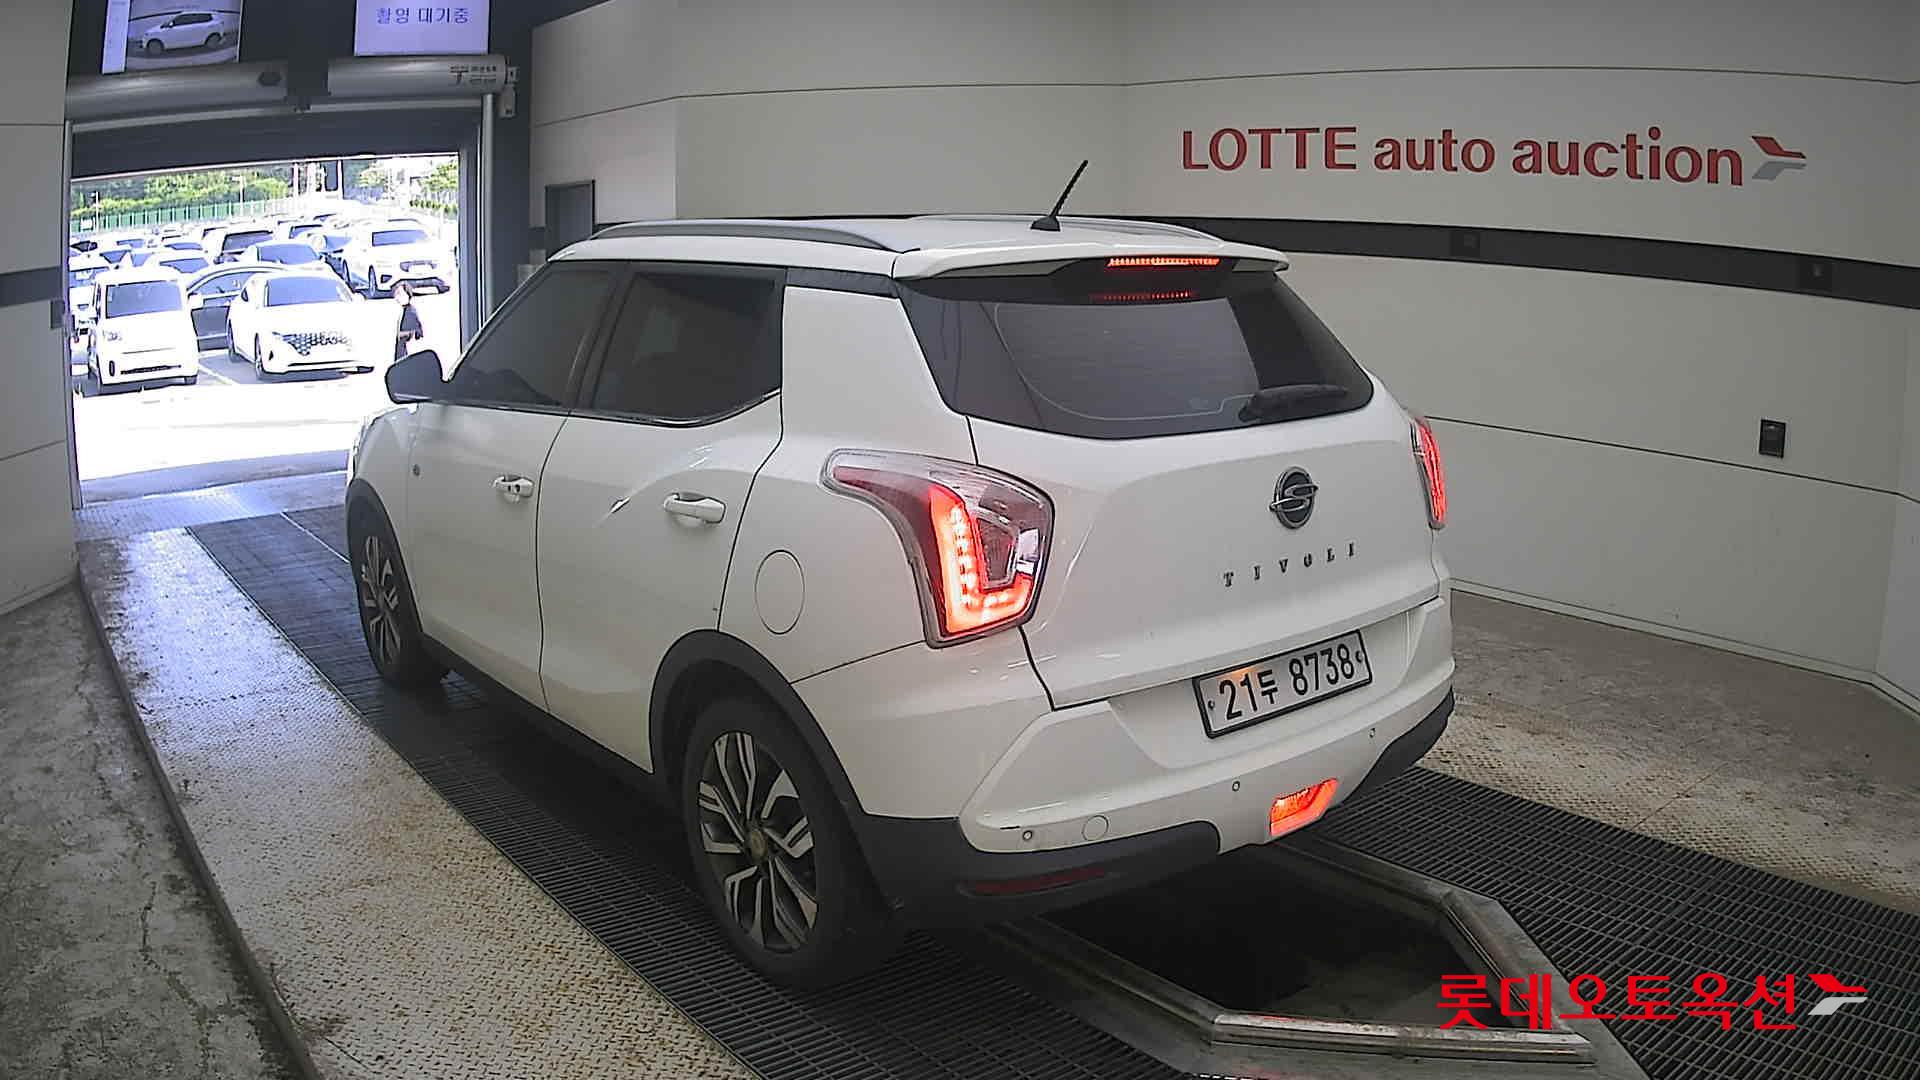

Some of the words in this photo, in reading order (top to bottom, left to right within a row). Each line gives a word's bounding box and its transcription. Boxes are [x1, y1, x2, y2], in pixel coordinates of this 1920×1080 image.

[418, 7, 469, 24] 대기중
[1182, 127, 1357, 170] LOTTE
[1374, 129, 1496, 172] auto
[1512, 126, 1744, 186] auction
[1223, 542, 1355, 587] TIVOLI
[1219, 670, 1278, 720] 21두
[1289, 643, 1355, 696] 8738
